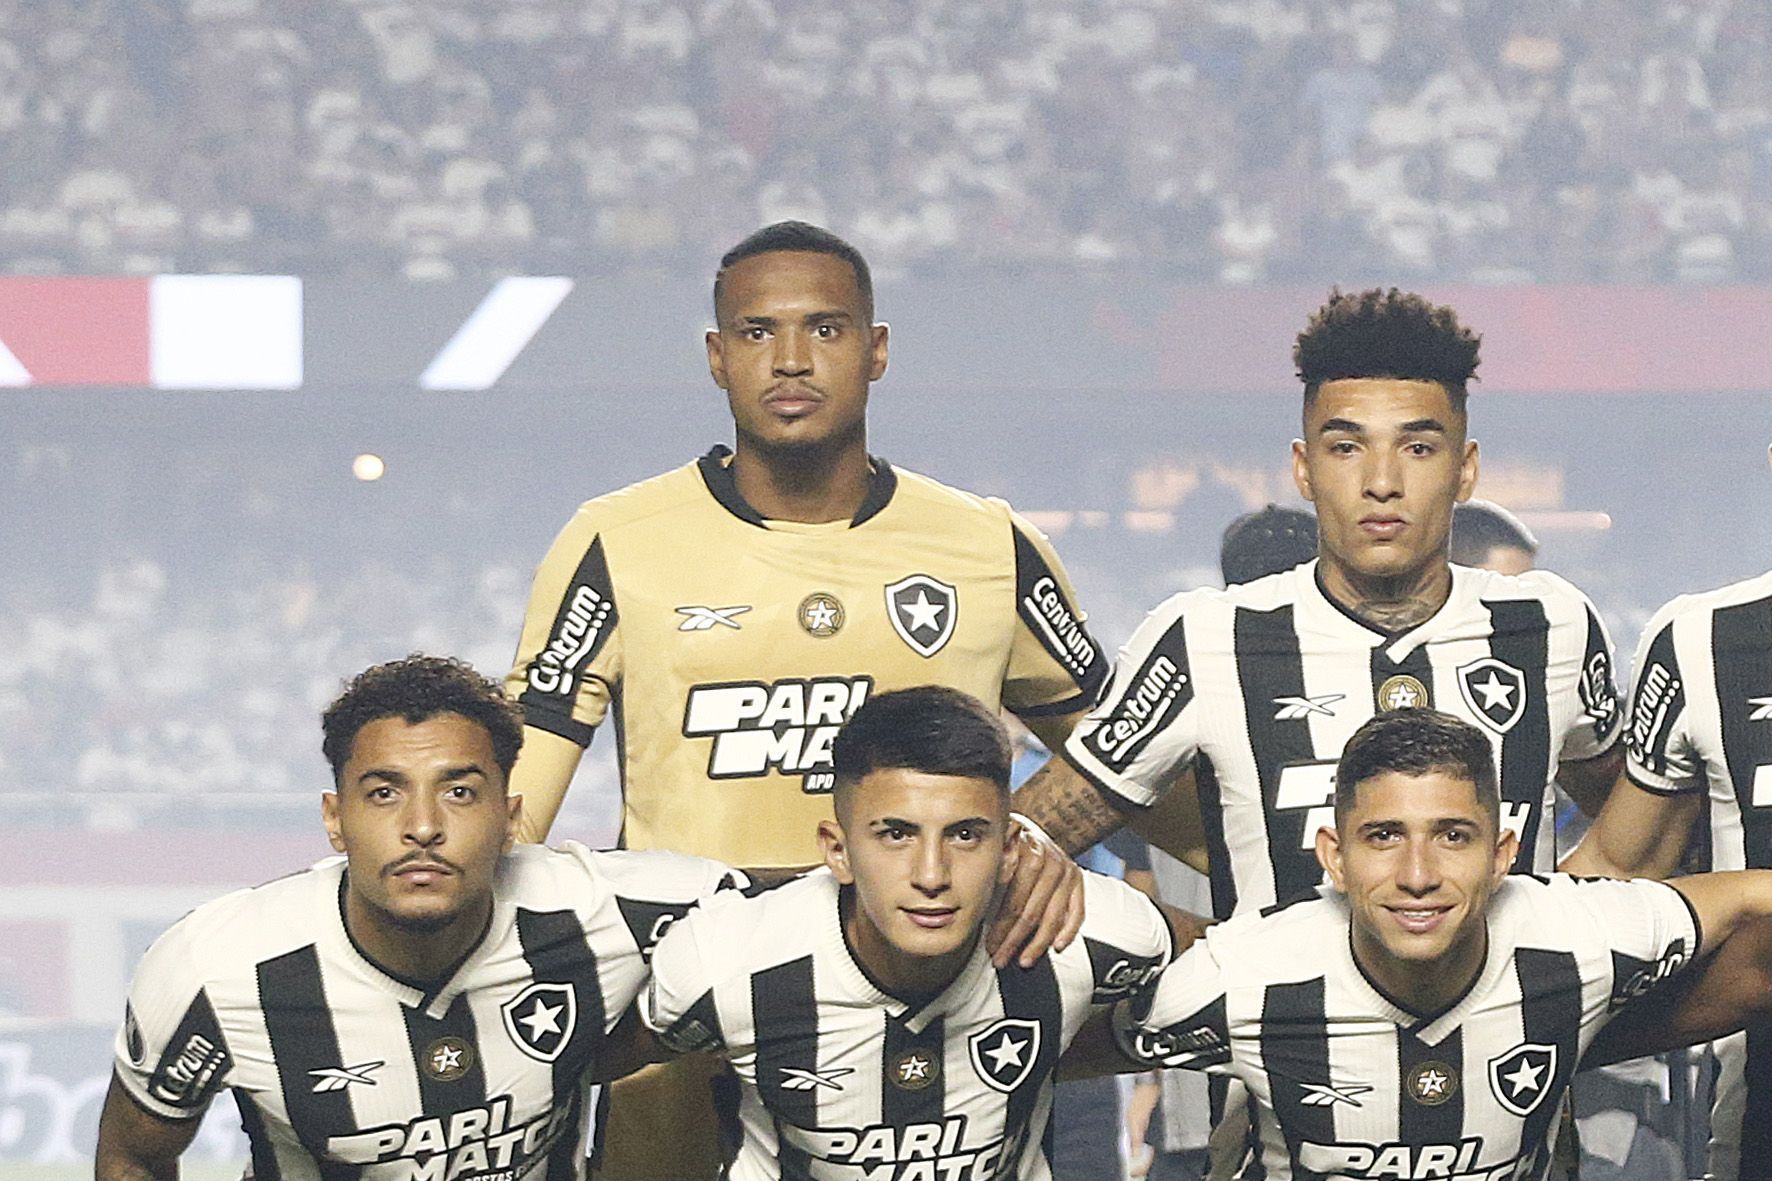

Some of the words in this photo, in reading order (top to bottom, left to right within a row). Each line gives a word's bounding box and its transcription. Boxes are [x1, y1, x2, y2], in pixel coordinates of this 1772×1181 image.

[529, 584, 601, 692] Cntrum
[1033, 577, 1096, 667] Centrum
[328, 1100, 508, 1163] PARI
[784, 1119, 962, 1163] PARI
[1300, 1140, 1479, 1180] PARI
